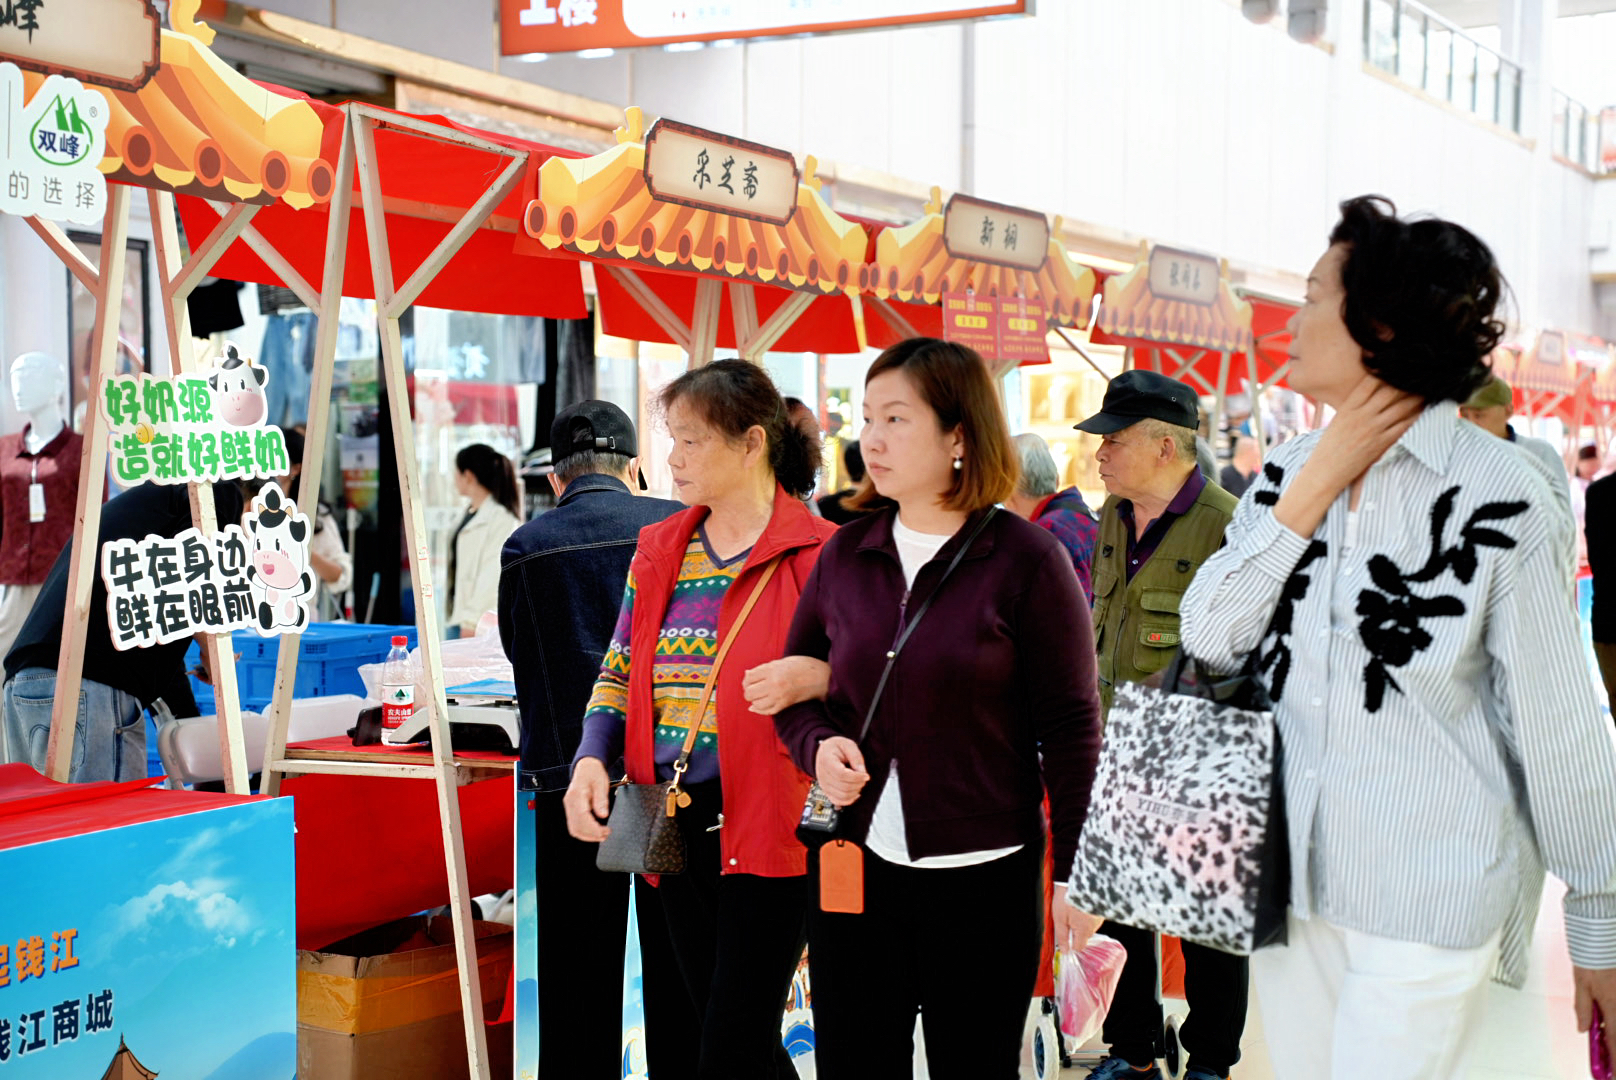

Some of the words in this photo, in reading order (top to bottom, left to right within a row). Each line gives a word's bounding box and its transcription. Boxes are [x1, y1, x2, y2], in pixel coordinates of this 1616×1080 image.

[37, 129, 80, 159] 双峰
[8, 170, 95, 209] 的选择
[693, 147, 758, 200] 采芝斋
[105, 378, 213, 426] 好奶源
[114, 429, 287, 481] 造就好鲜奶
[109, 532, 246, 592] 牛在身边
[115, 577, 257, 642] 鲜在眼前
